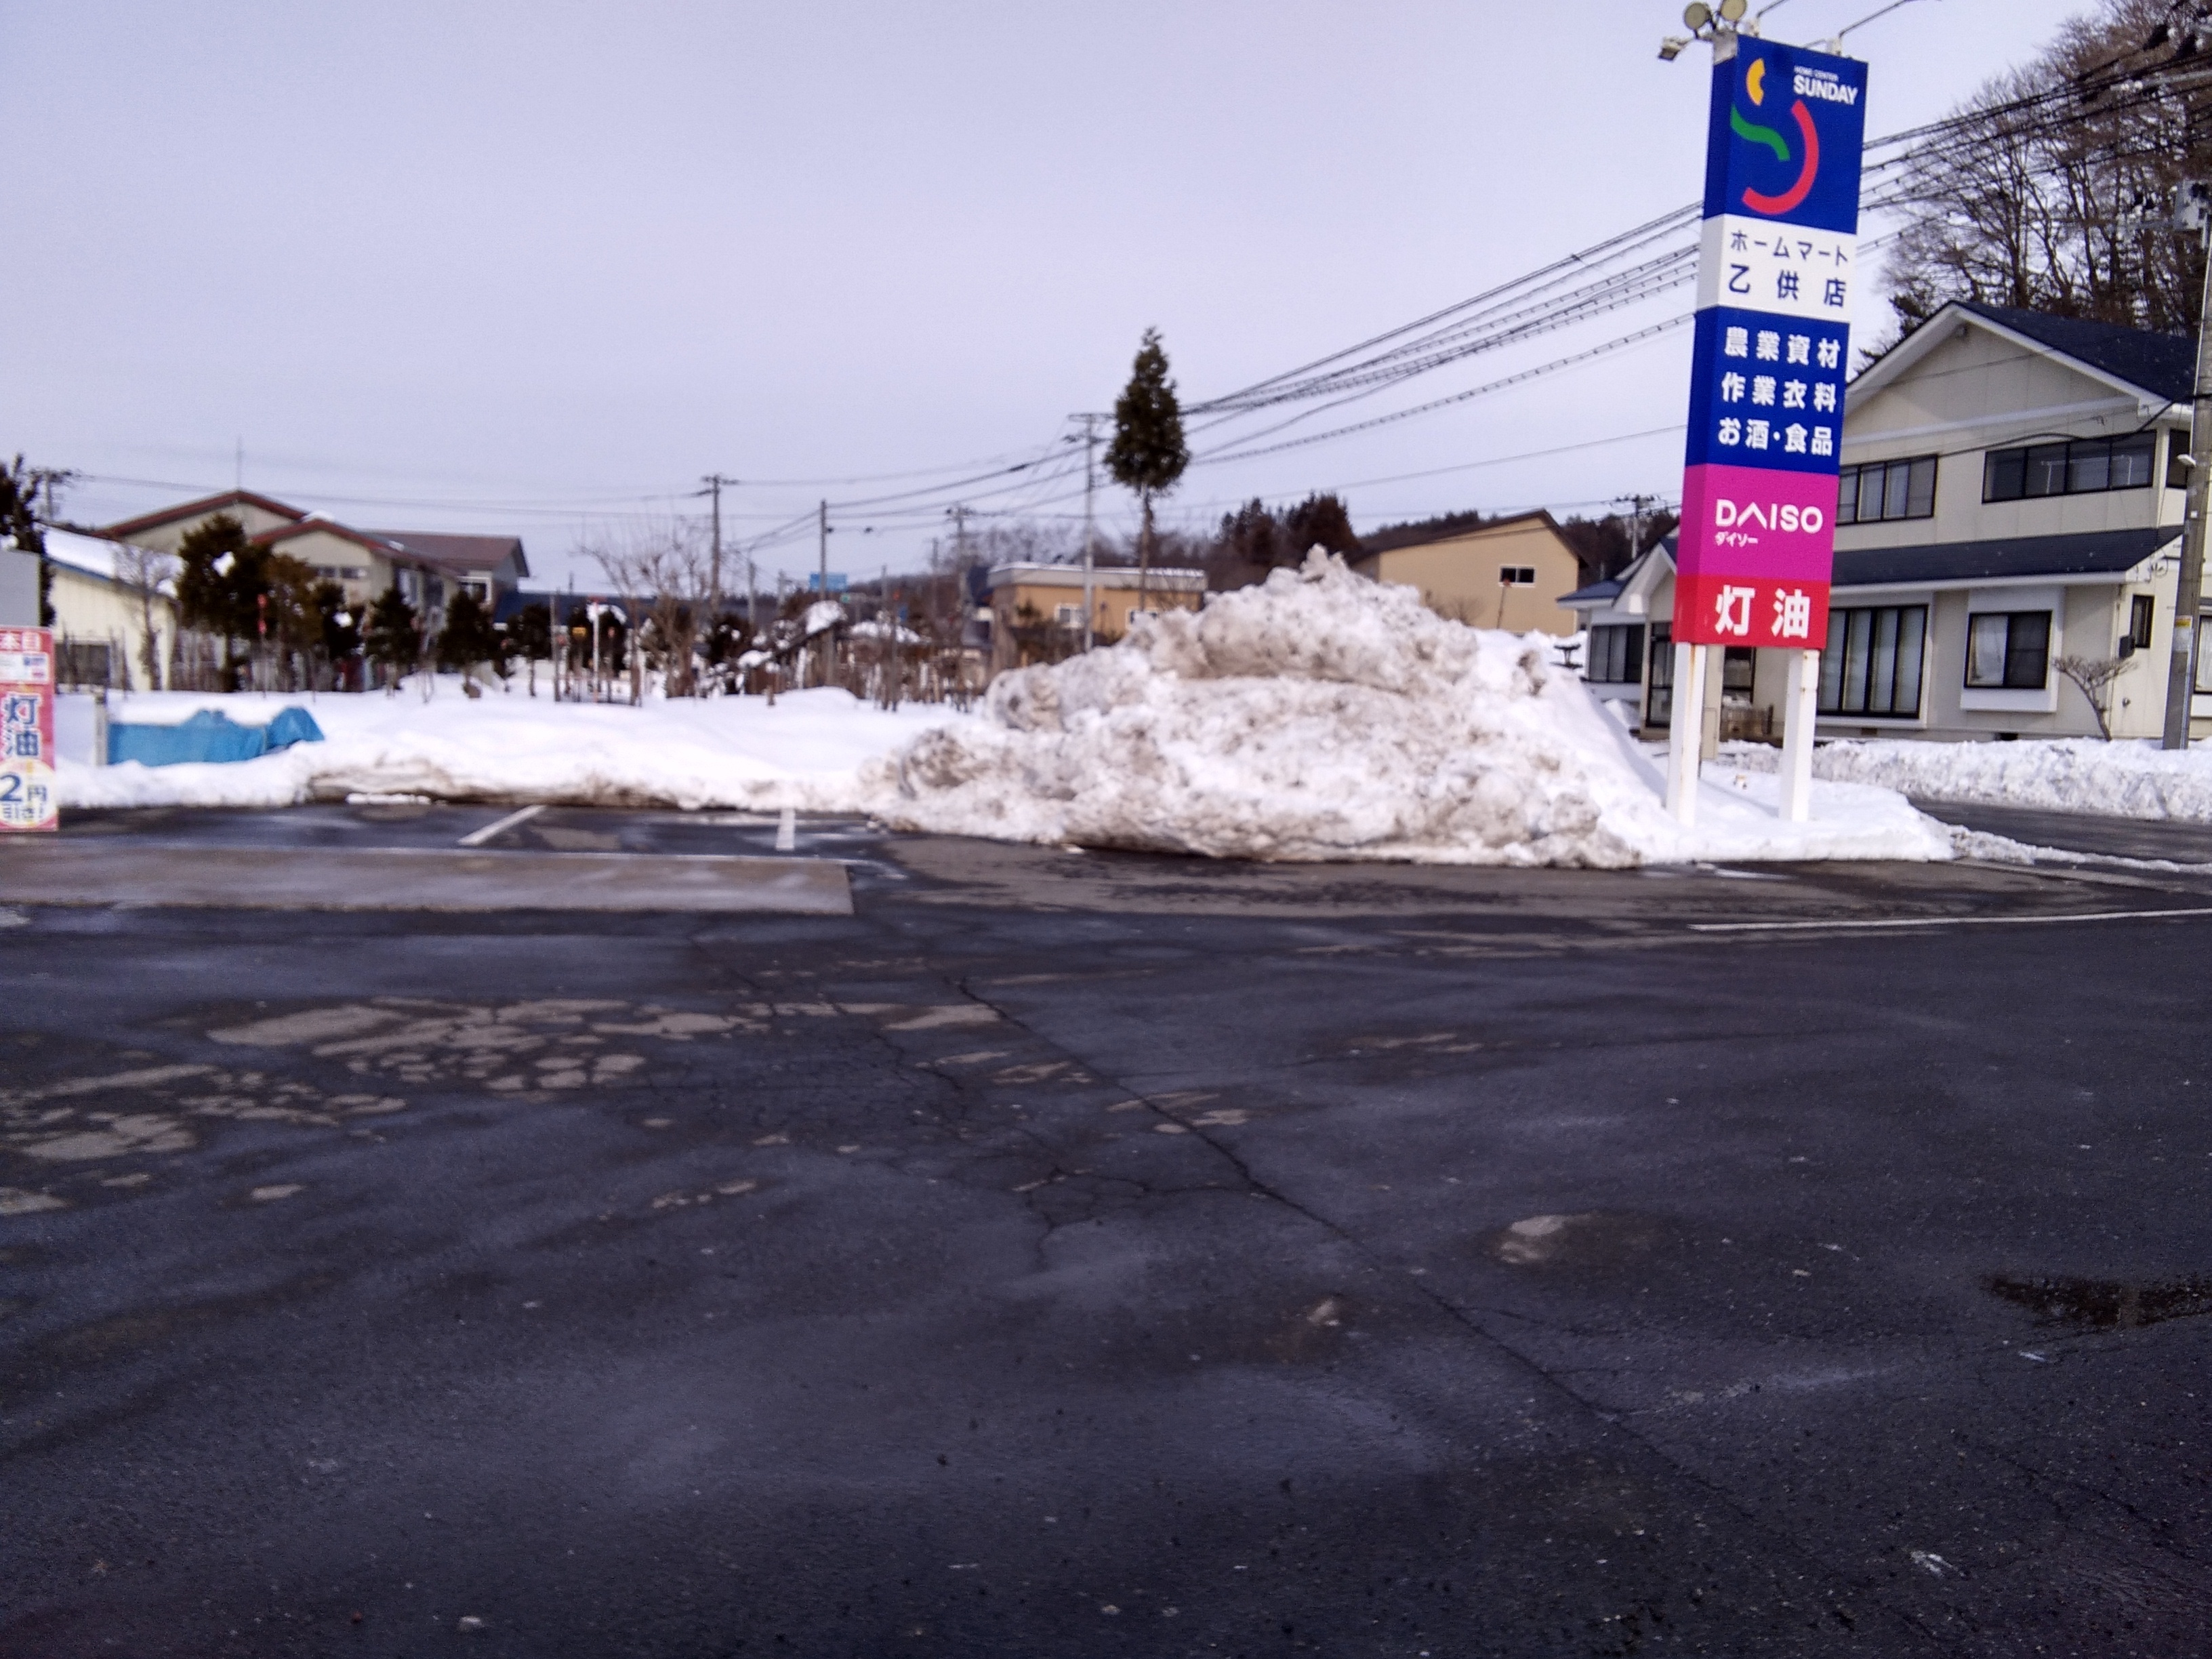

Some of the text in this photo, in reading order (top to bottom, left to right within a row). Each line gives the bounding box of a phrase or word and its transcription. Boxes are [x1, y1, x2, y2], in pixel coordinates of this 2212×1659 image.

[1794, 75, 1858, 105] SUNDAY
[1730, 230, 1848, 267] ホームマート
[1729, 264, 1846, 308] 乙供店
[1725, 326, 1841, 369] 農業資材
[1721, 372, 1836, 413] 作業衣料
[1718, 417, 1832, 456] お酒・食品
[1715, 499, 1823, 533] DAISO
[1715, 532, 1758, 547] ダイソー
[1715, 584, 1811, 639] 灯油
[4, 696, 39, 756] 灯油
